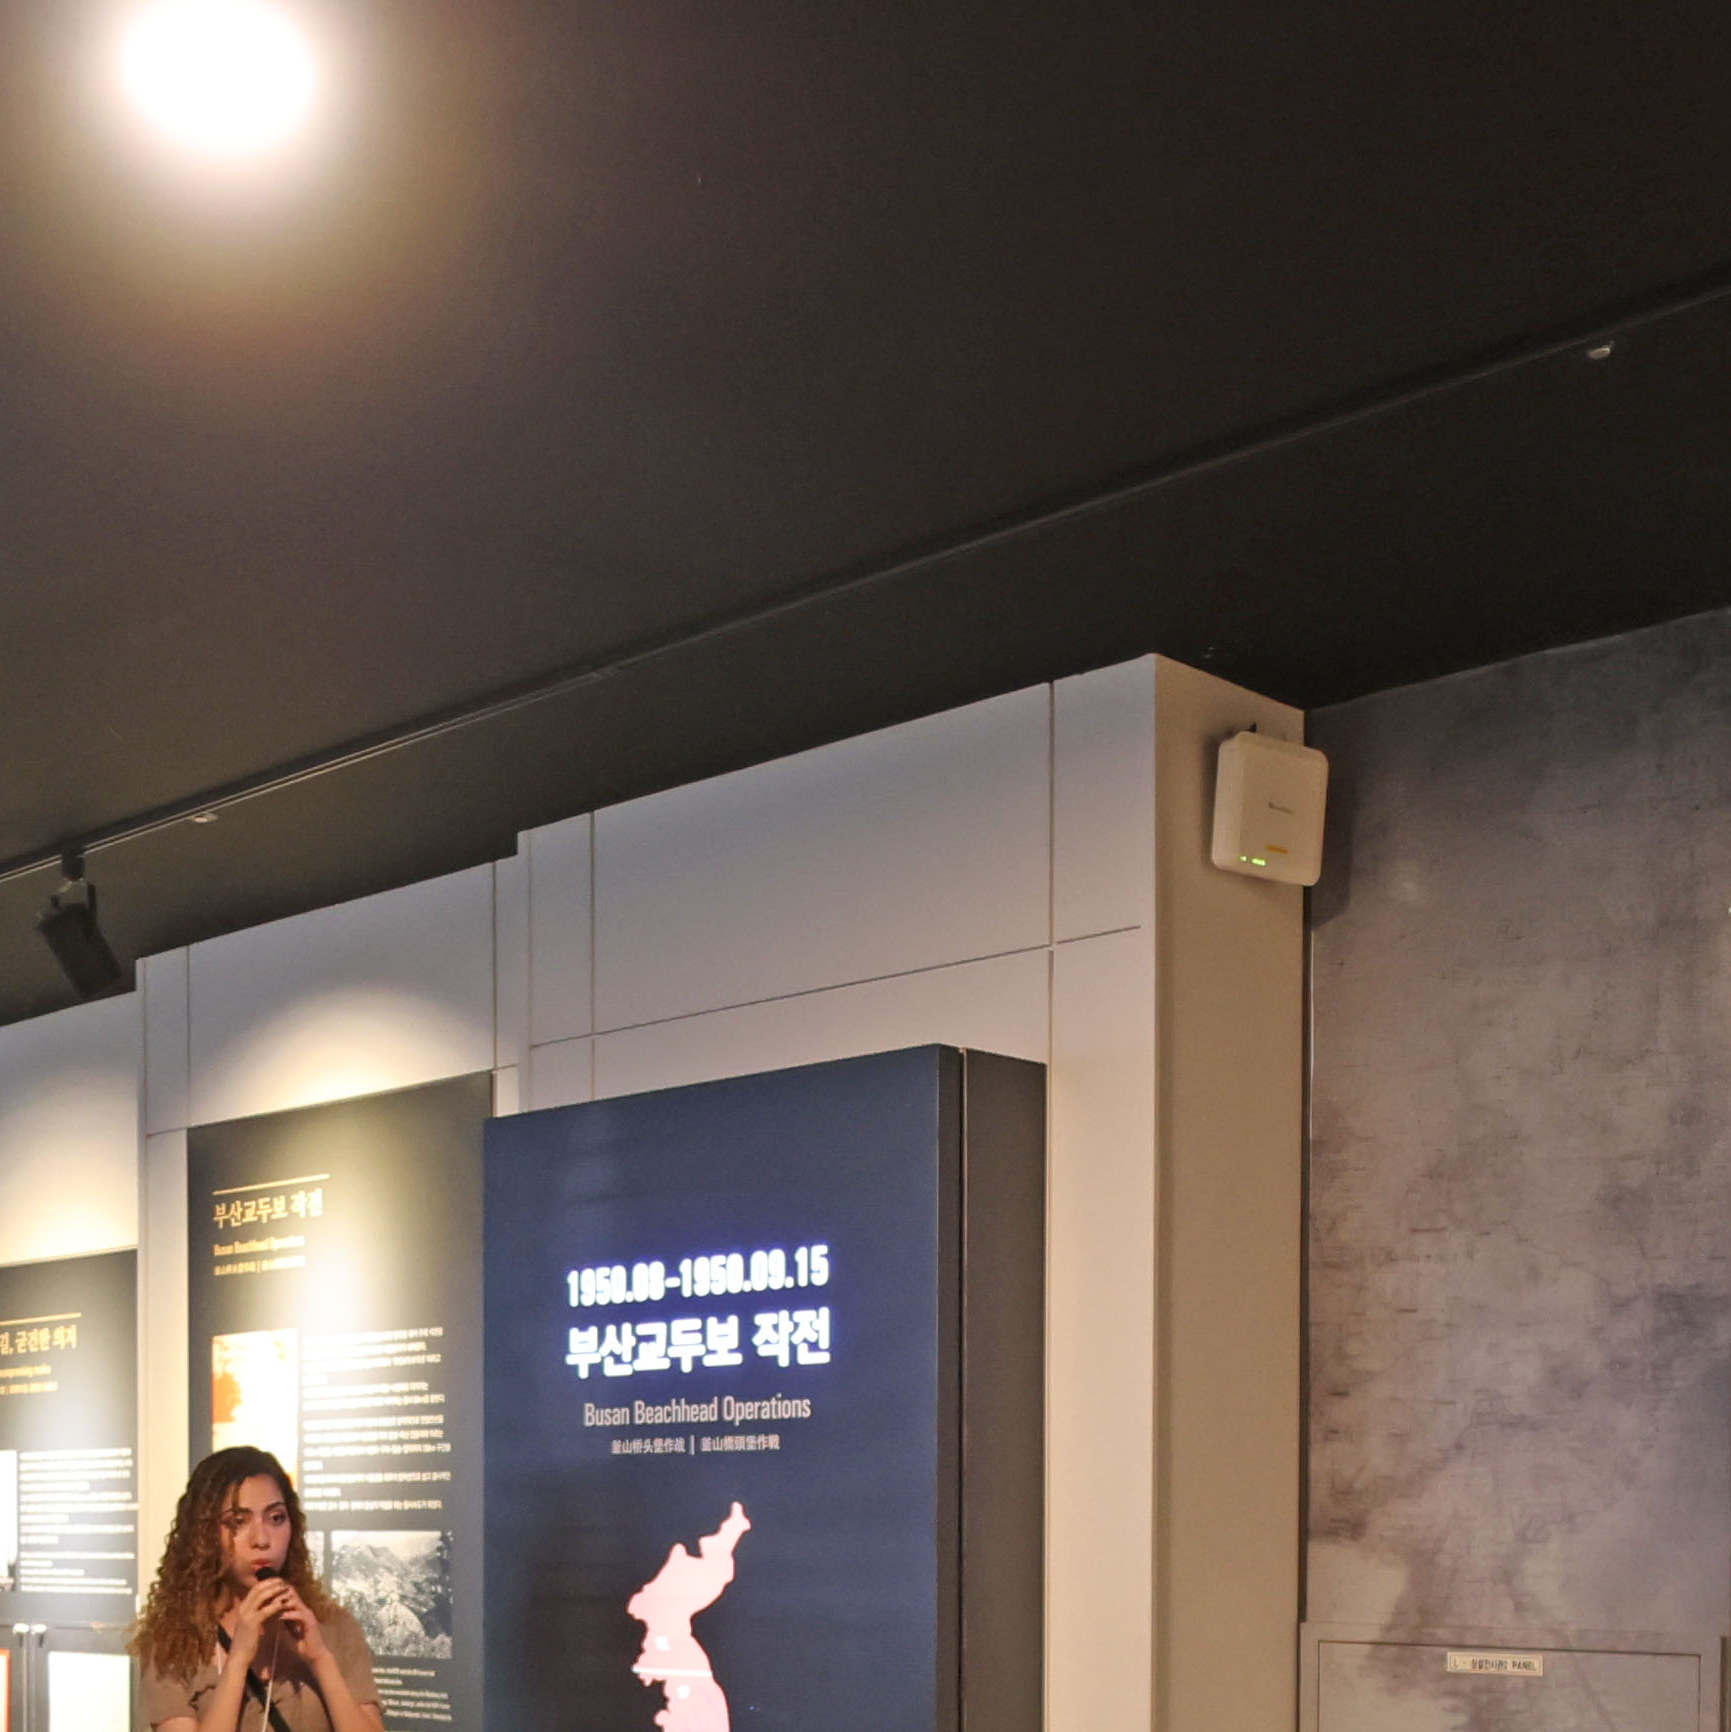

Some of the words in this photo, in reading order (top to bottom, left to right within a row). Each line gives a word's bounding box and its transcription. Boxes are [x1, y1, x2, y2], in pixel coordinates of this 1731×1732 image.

[213, 1194, 288, 1229] 부산교두보
[565, 1315, 743, 1380] 부산교두보
[752, 1307, 831, 1367] 작전
[583, 1402, 630, 1427] Busan
[634, 1396, 719, 1425] Beachhead
[723, 1392, 812, 1427] Operations
